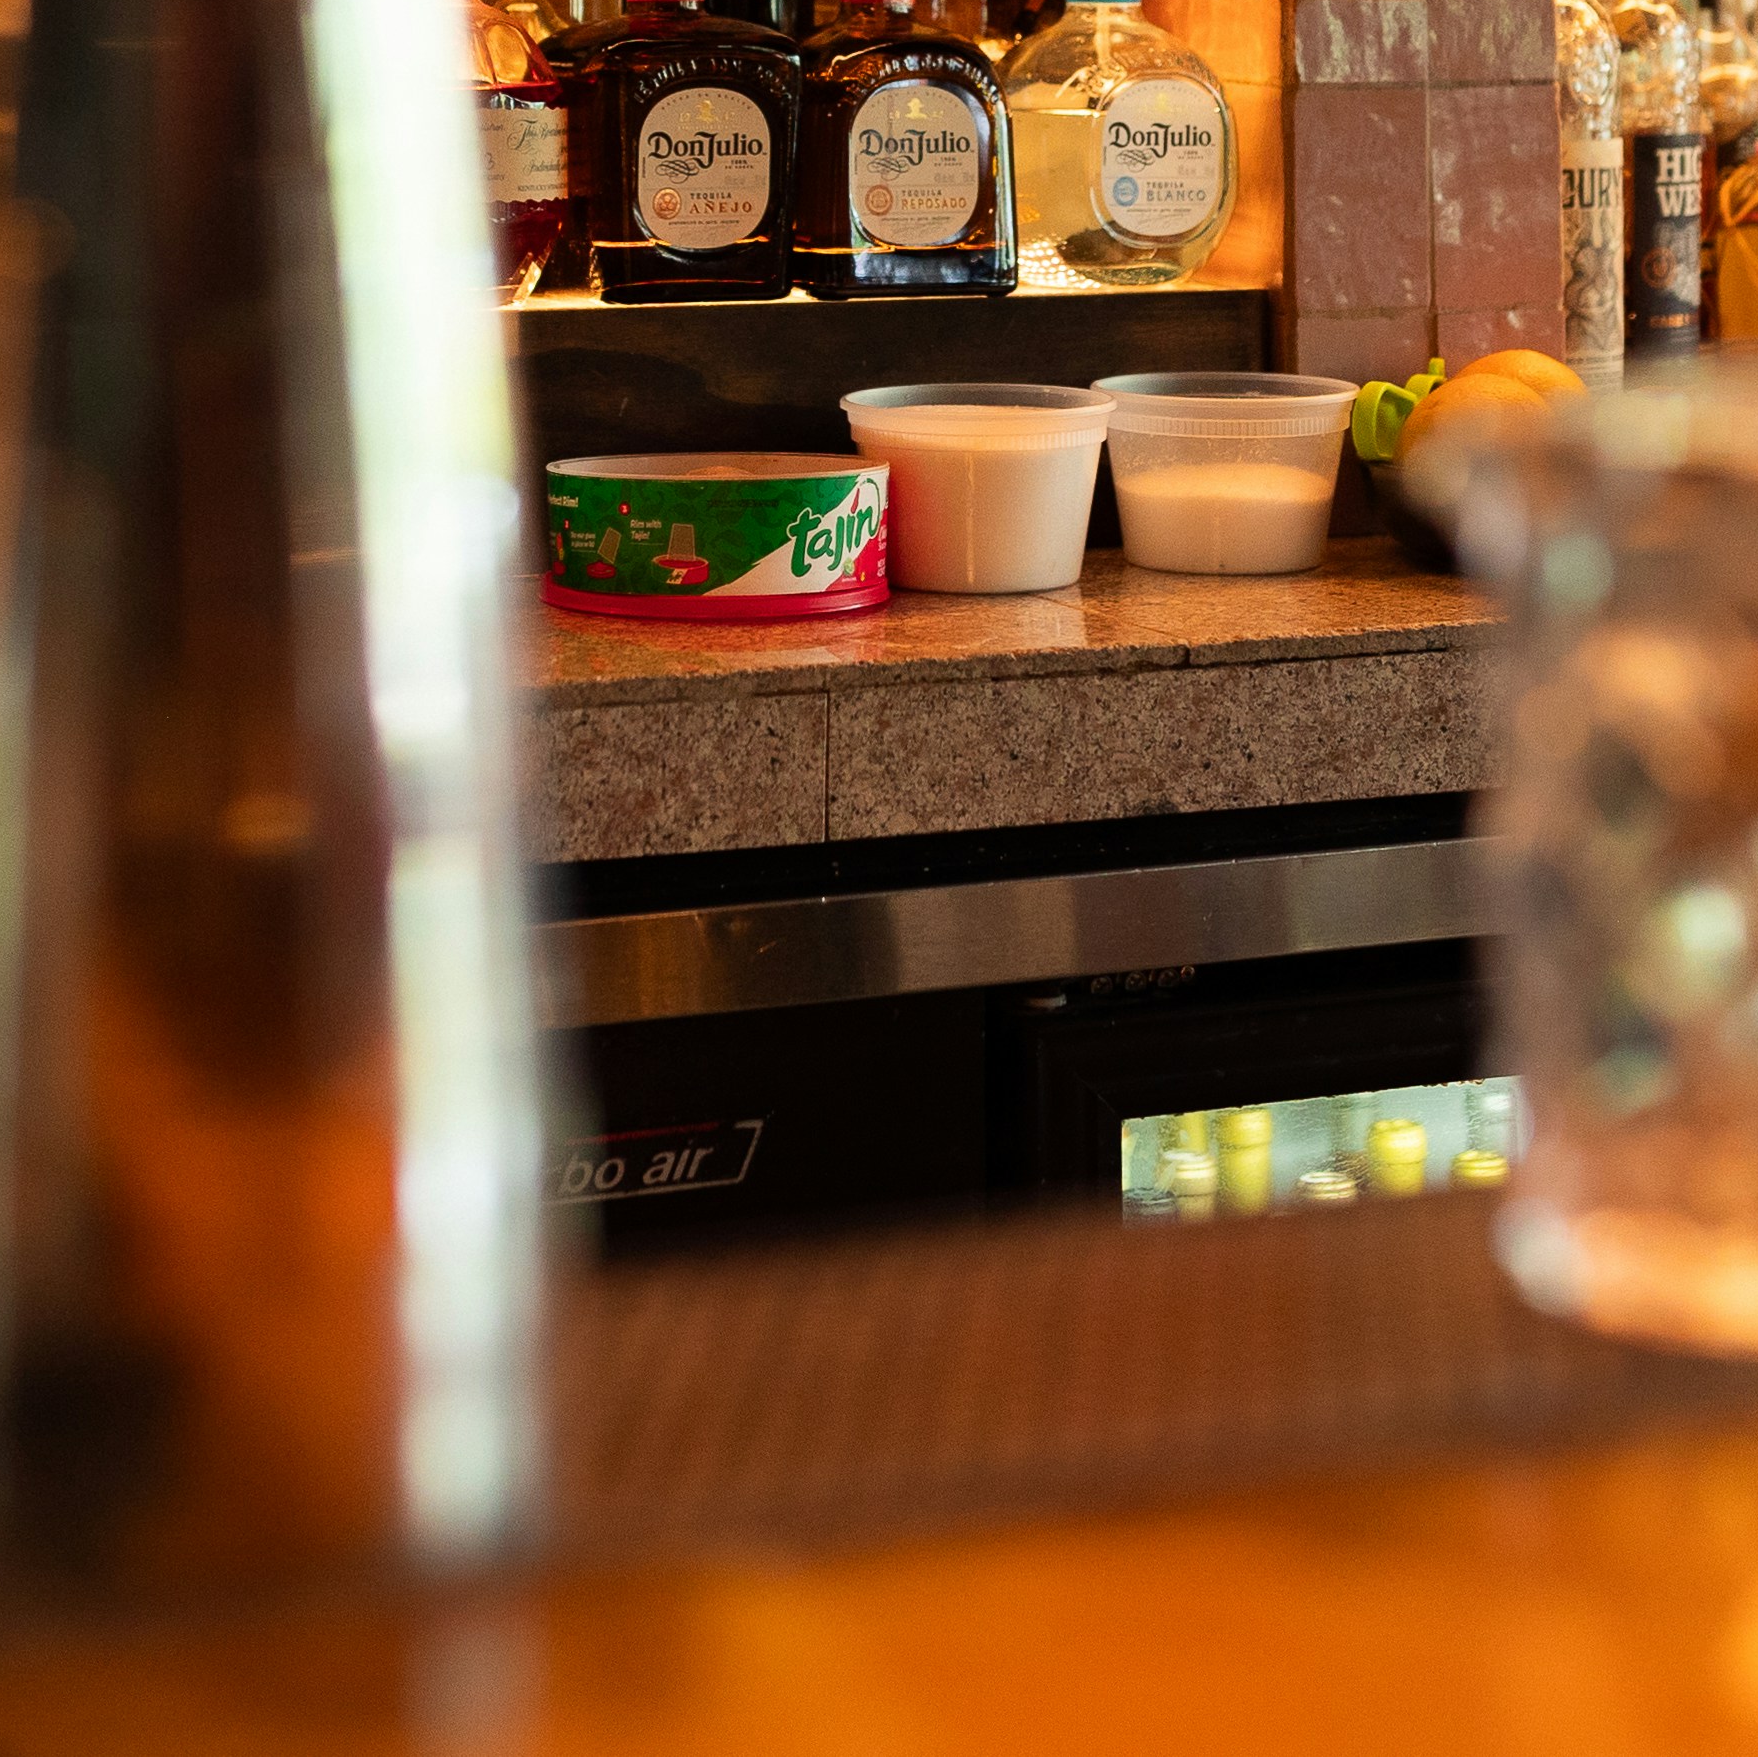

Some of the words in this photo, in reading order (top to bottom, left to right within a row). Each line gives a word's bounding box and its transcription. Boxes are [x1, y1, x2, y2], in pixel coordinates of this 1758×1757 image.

[1146, 190, 1206, 202] BLANCO
[689, 200, 752, 214] AÑEJO
[901, 197, 967, 210] REPOSADO
[643, 1139, 715, 1185] air
